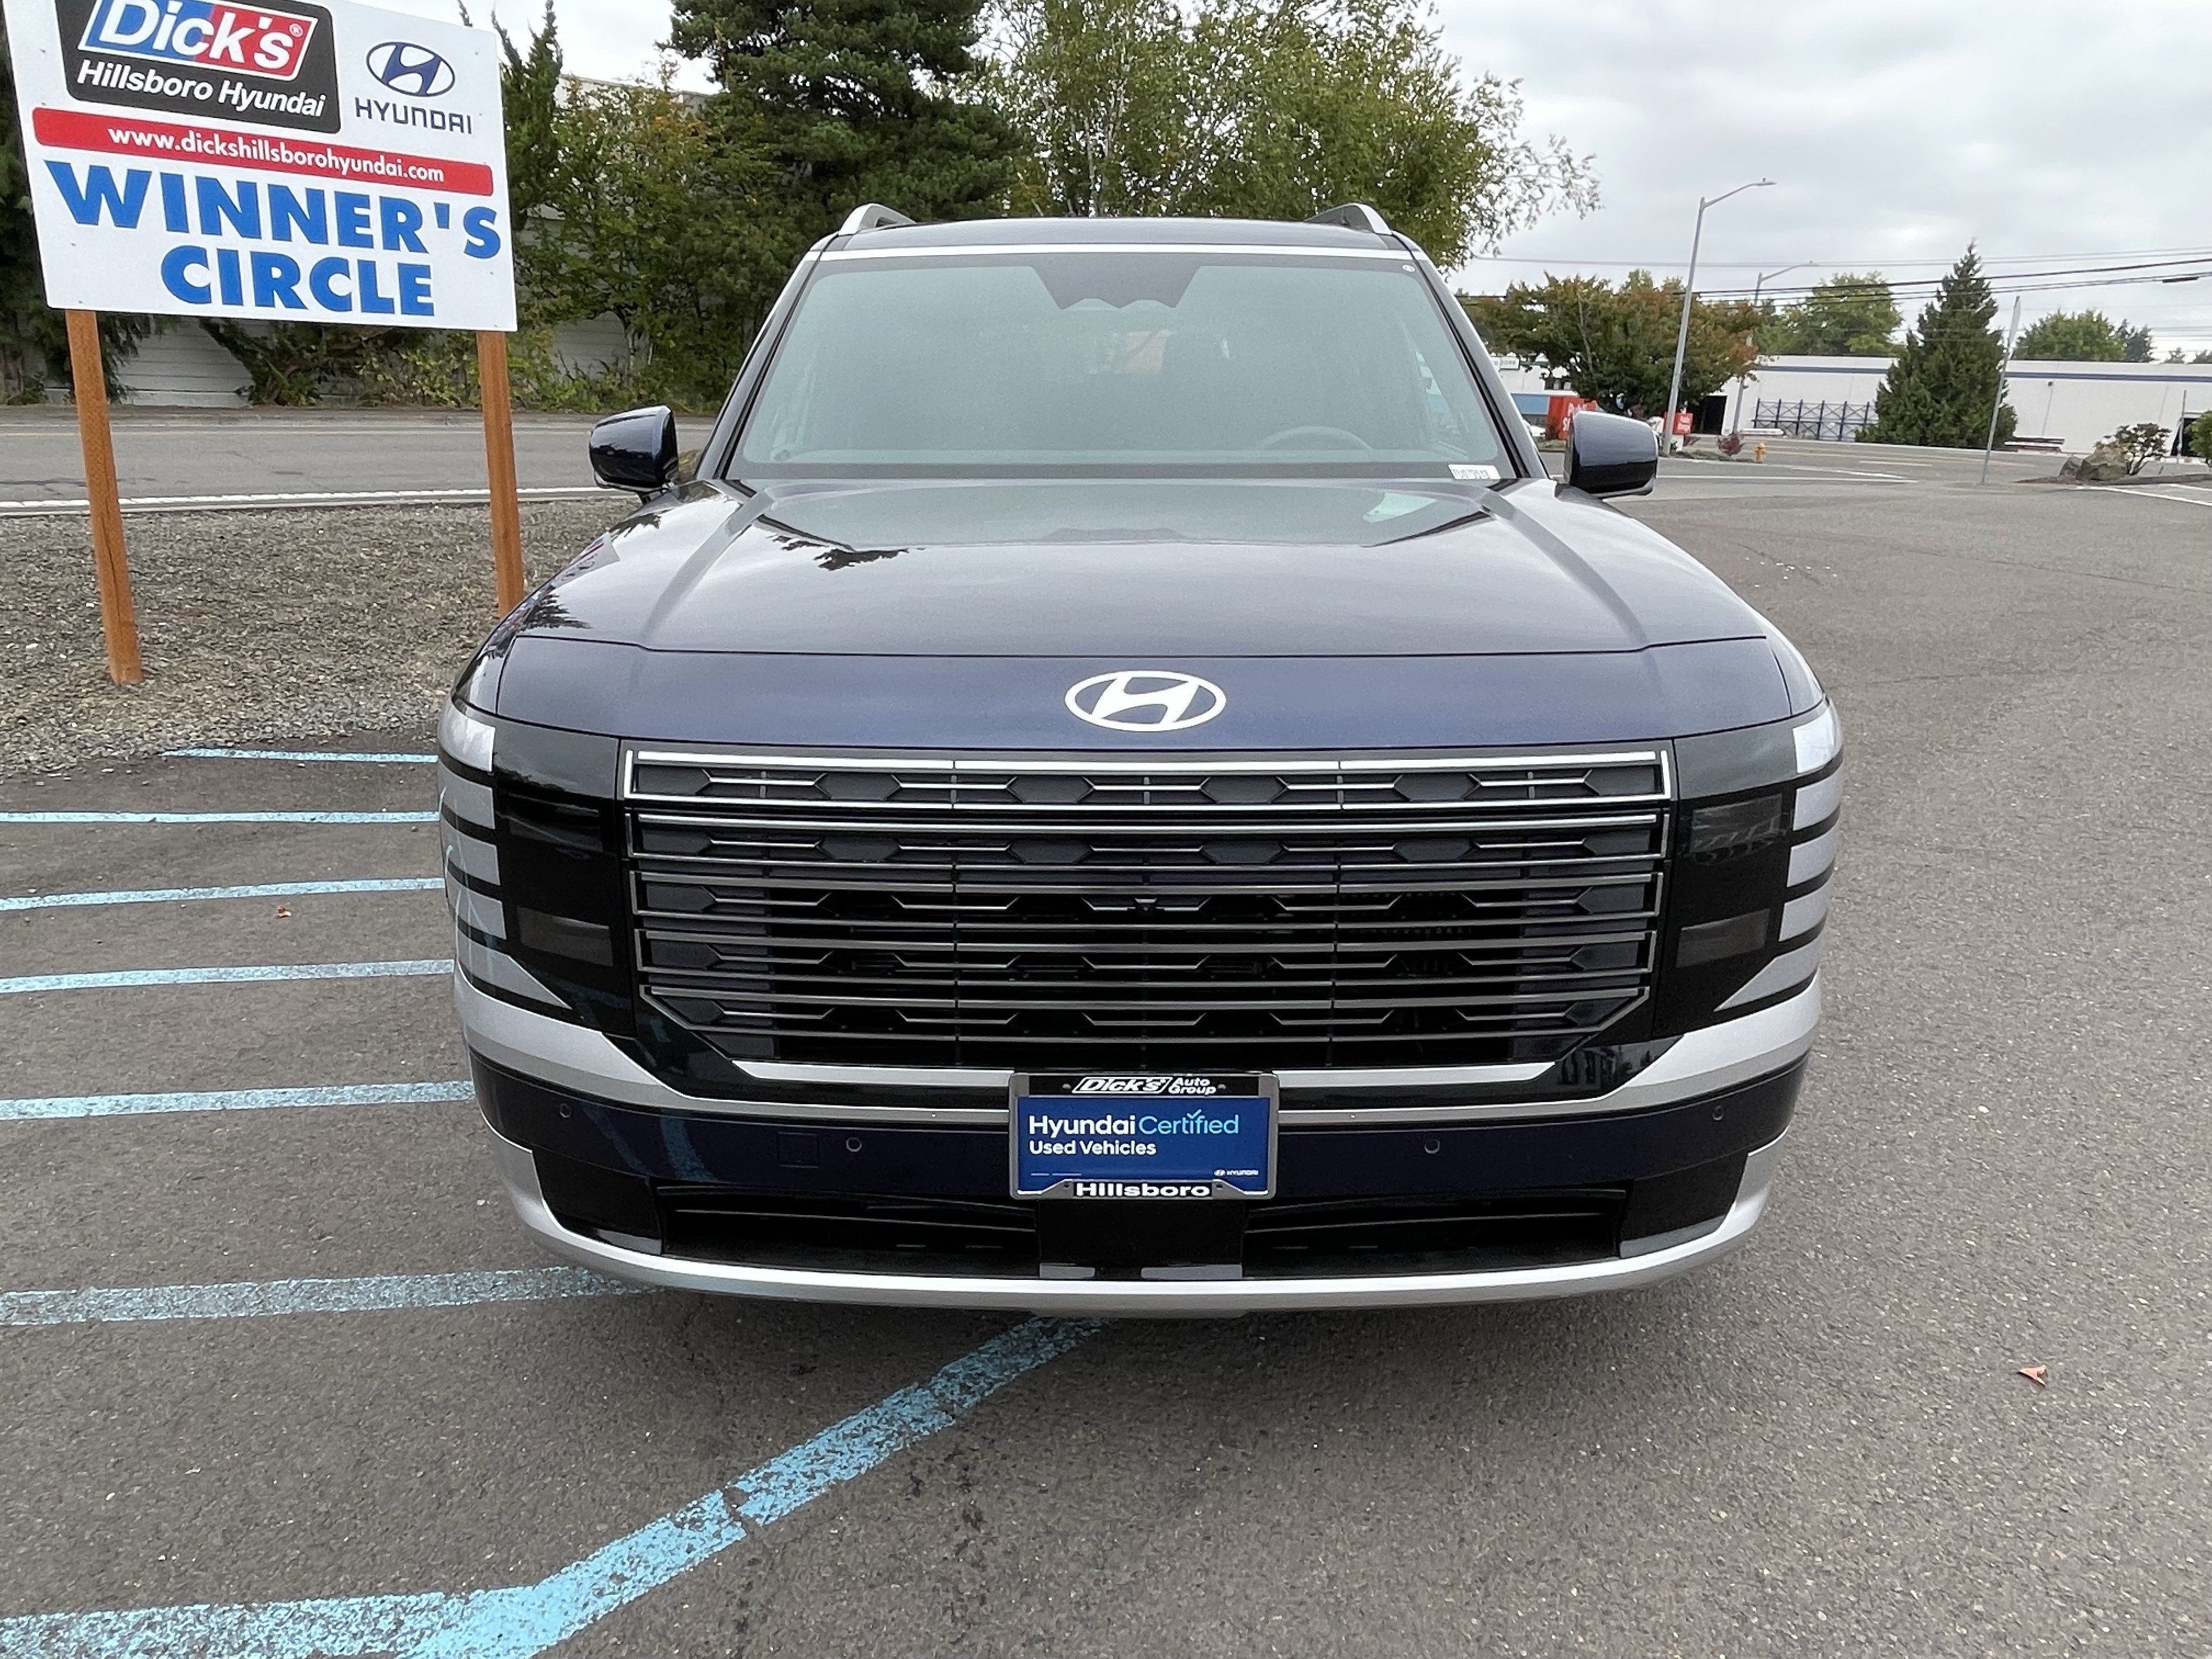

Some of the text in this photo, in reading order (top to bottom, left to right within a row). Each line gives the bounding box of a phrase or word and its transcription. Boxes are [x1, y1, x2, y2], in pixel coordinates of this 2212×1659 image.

[99, 0, 295, 69] Dick's
[77, 59, 326, 117] Hillsboro Hyundai
[355, 97, 472, 135] HYUNDAI
[108, 127, 445, 183] www.dickshillsborohyundai.com
[43, 159, 501, 259] WINNER'S
[160, 245, 435, 317] CIRCLE
[1168, 1085, 1217, 1094] Group
[1176, 1077, 1210, 1086] Auto
[1029, 1109, 1239, 1138] Hyundai Certified
[1029, 1140, 1156, 1155] Used Vehicles
[1076, 1182, 1210, 1198] Hillsboro
